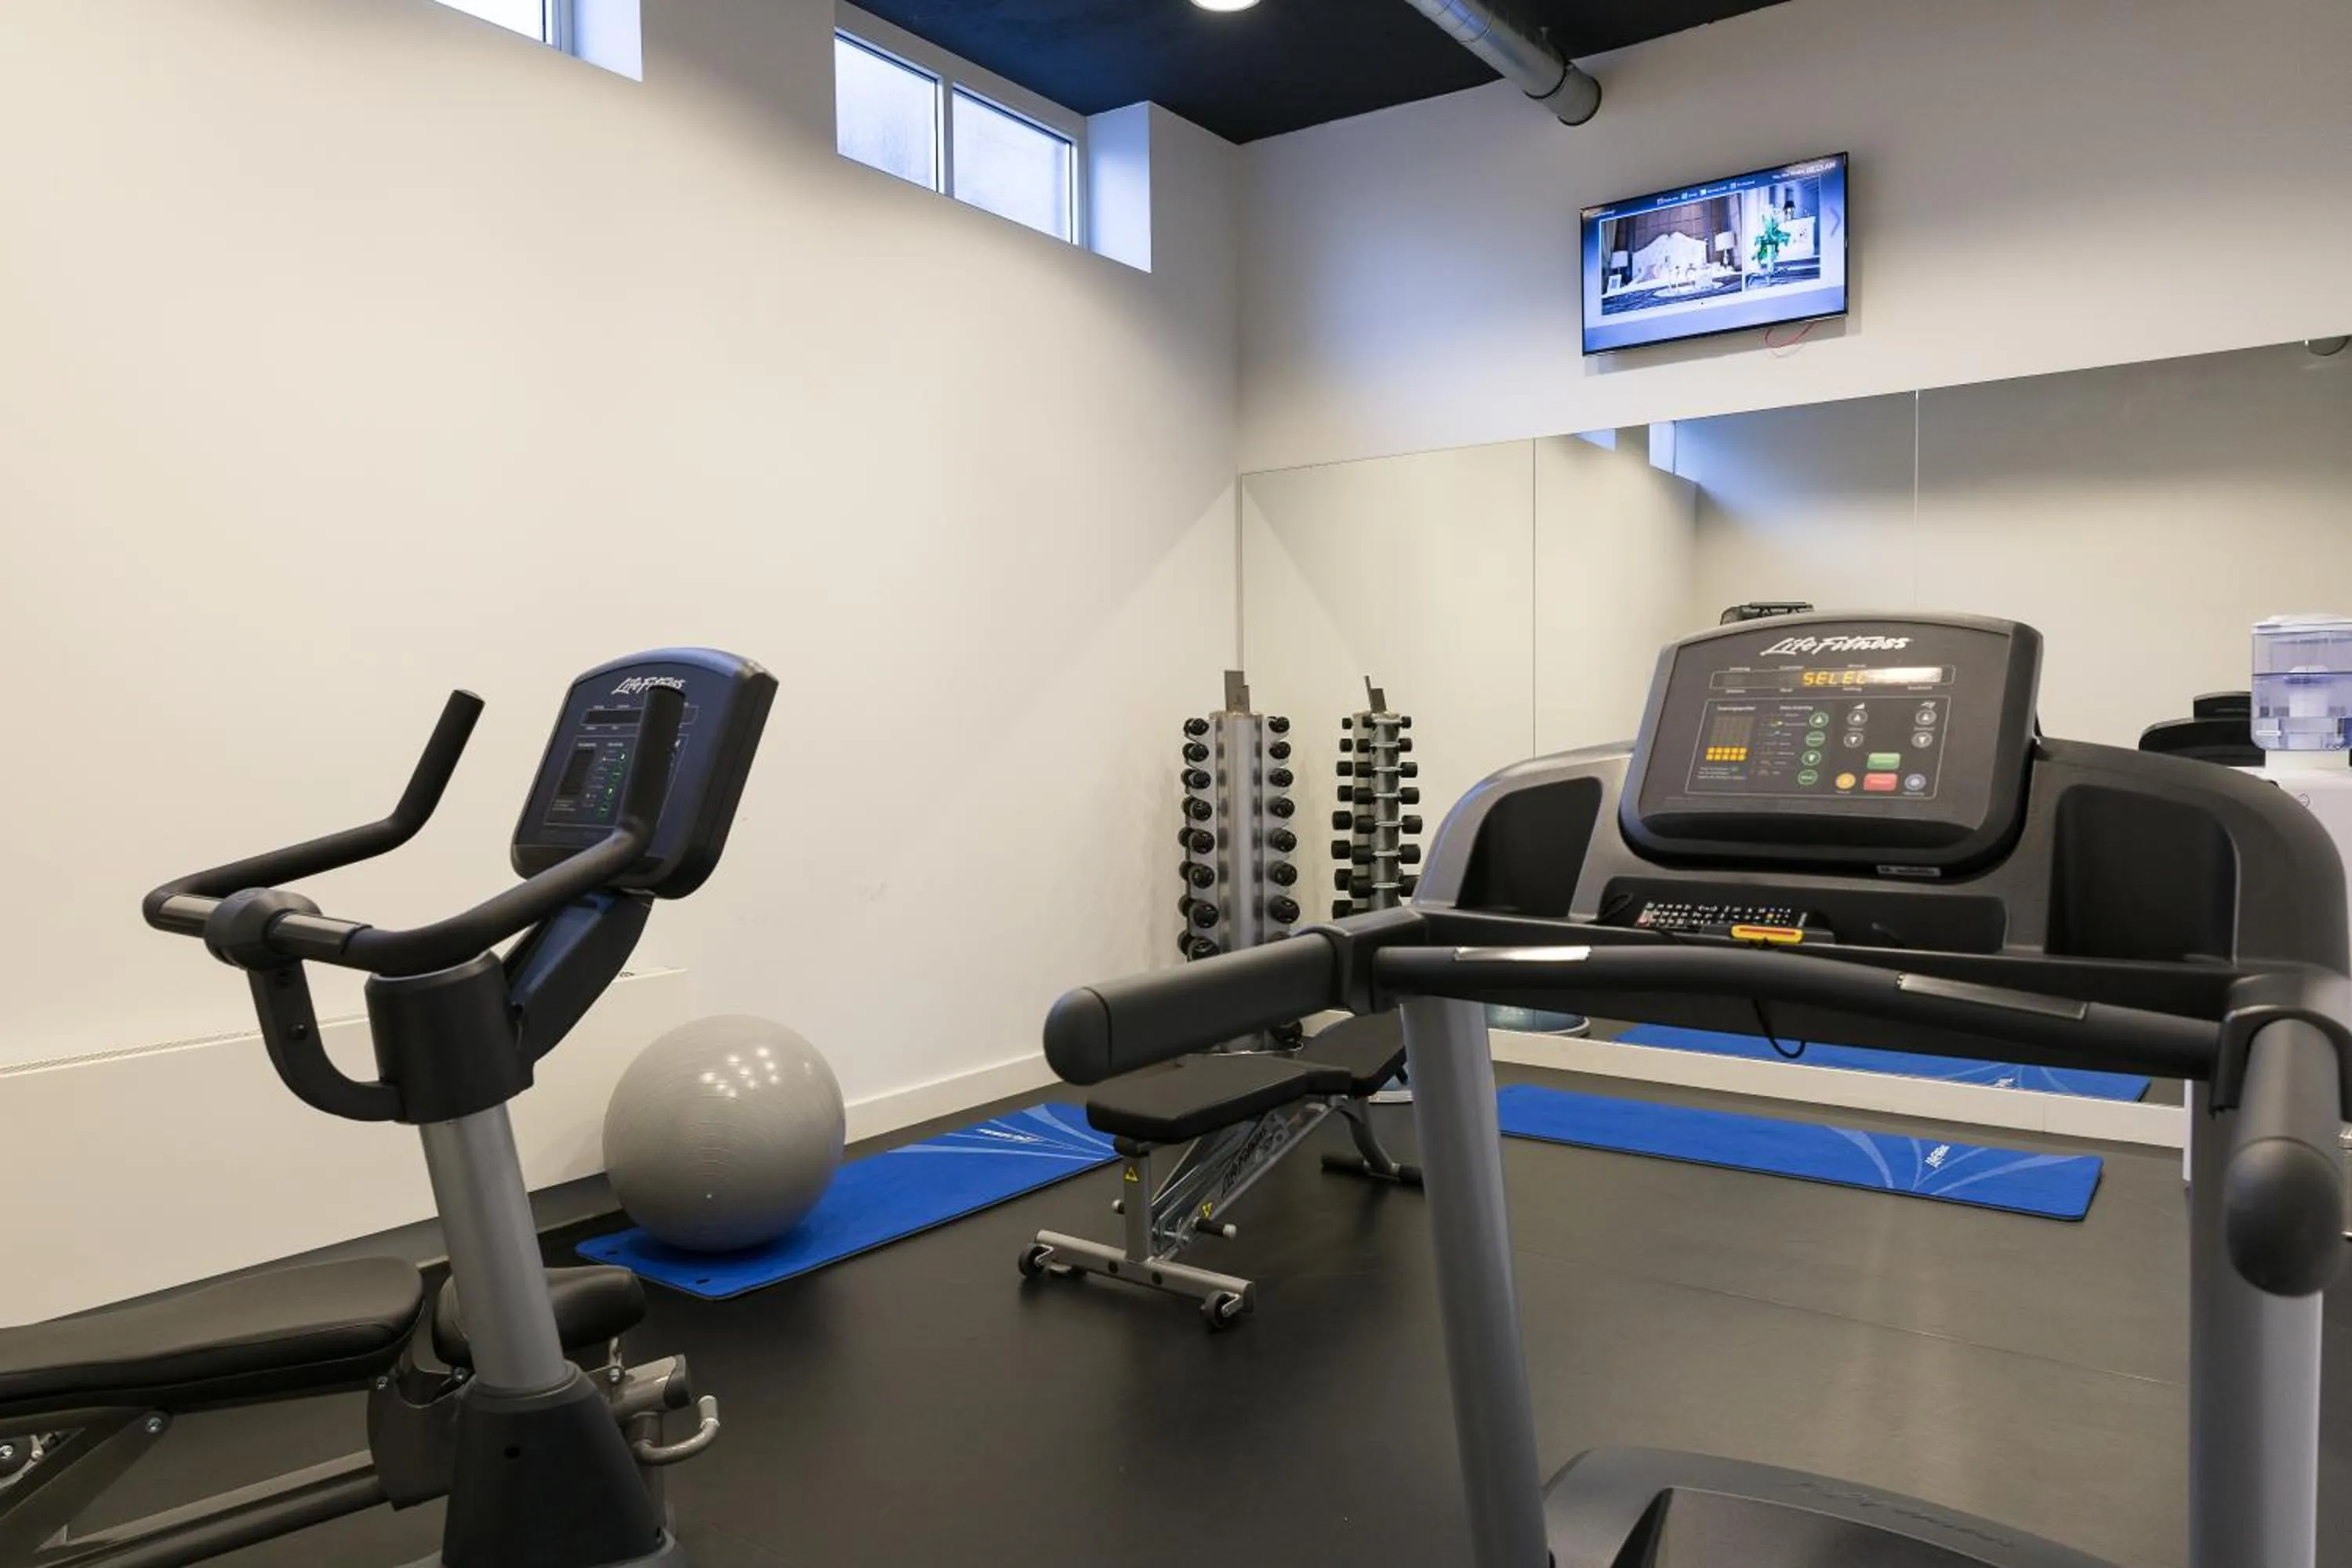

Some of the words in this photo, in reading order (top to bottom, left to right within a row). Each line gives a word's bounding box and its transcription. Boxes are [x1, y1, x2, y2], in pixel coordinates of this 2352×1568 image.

[1760, 637, 1816, 656] Life
[1812, 636, 1914, 655] Fitness
[1803, 670, 1872, 686] SELEC
